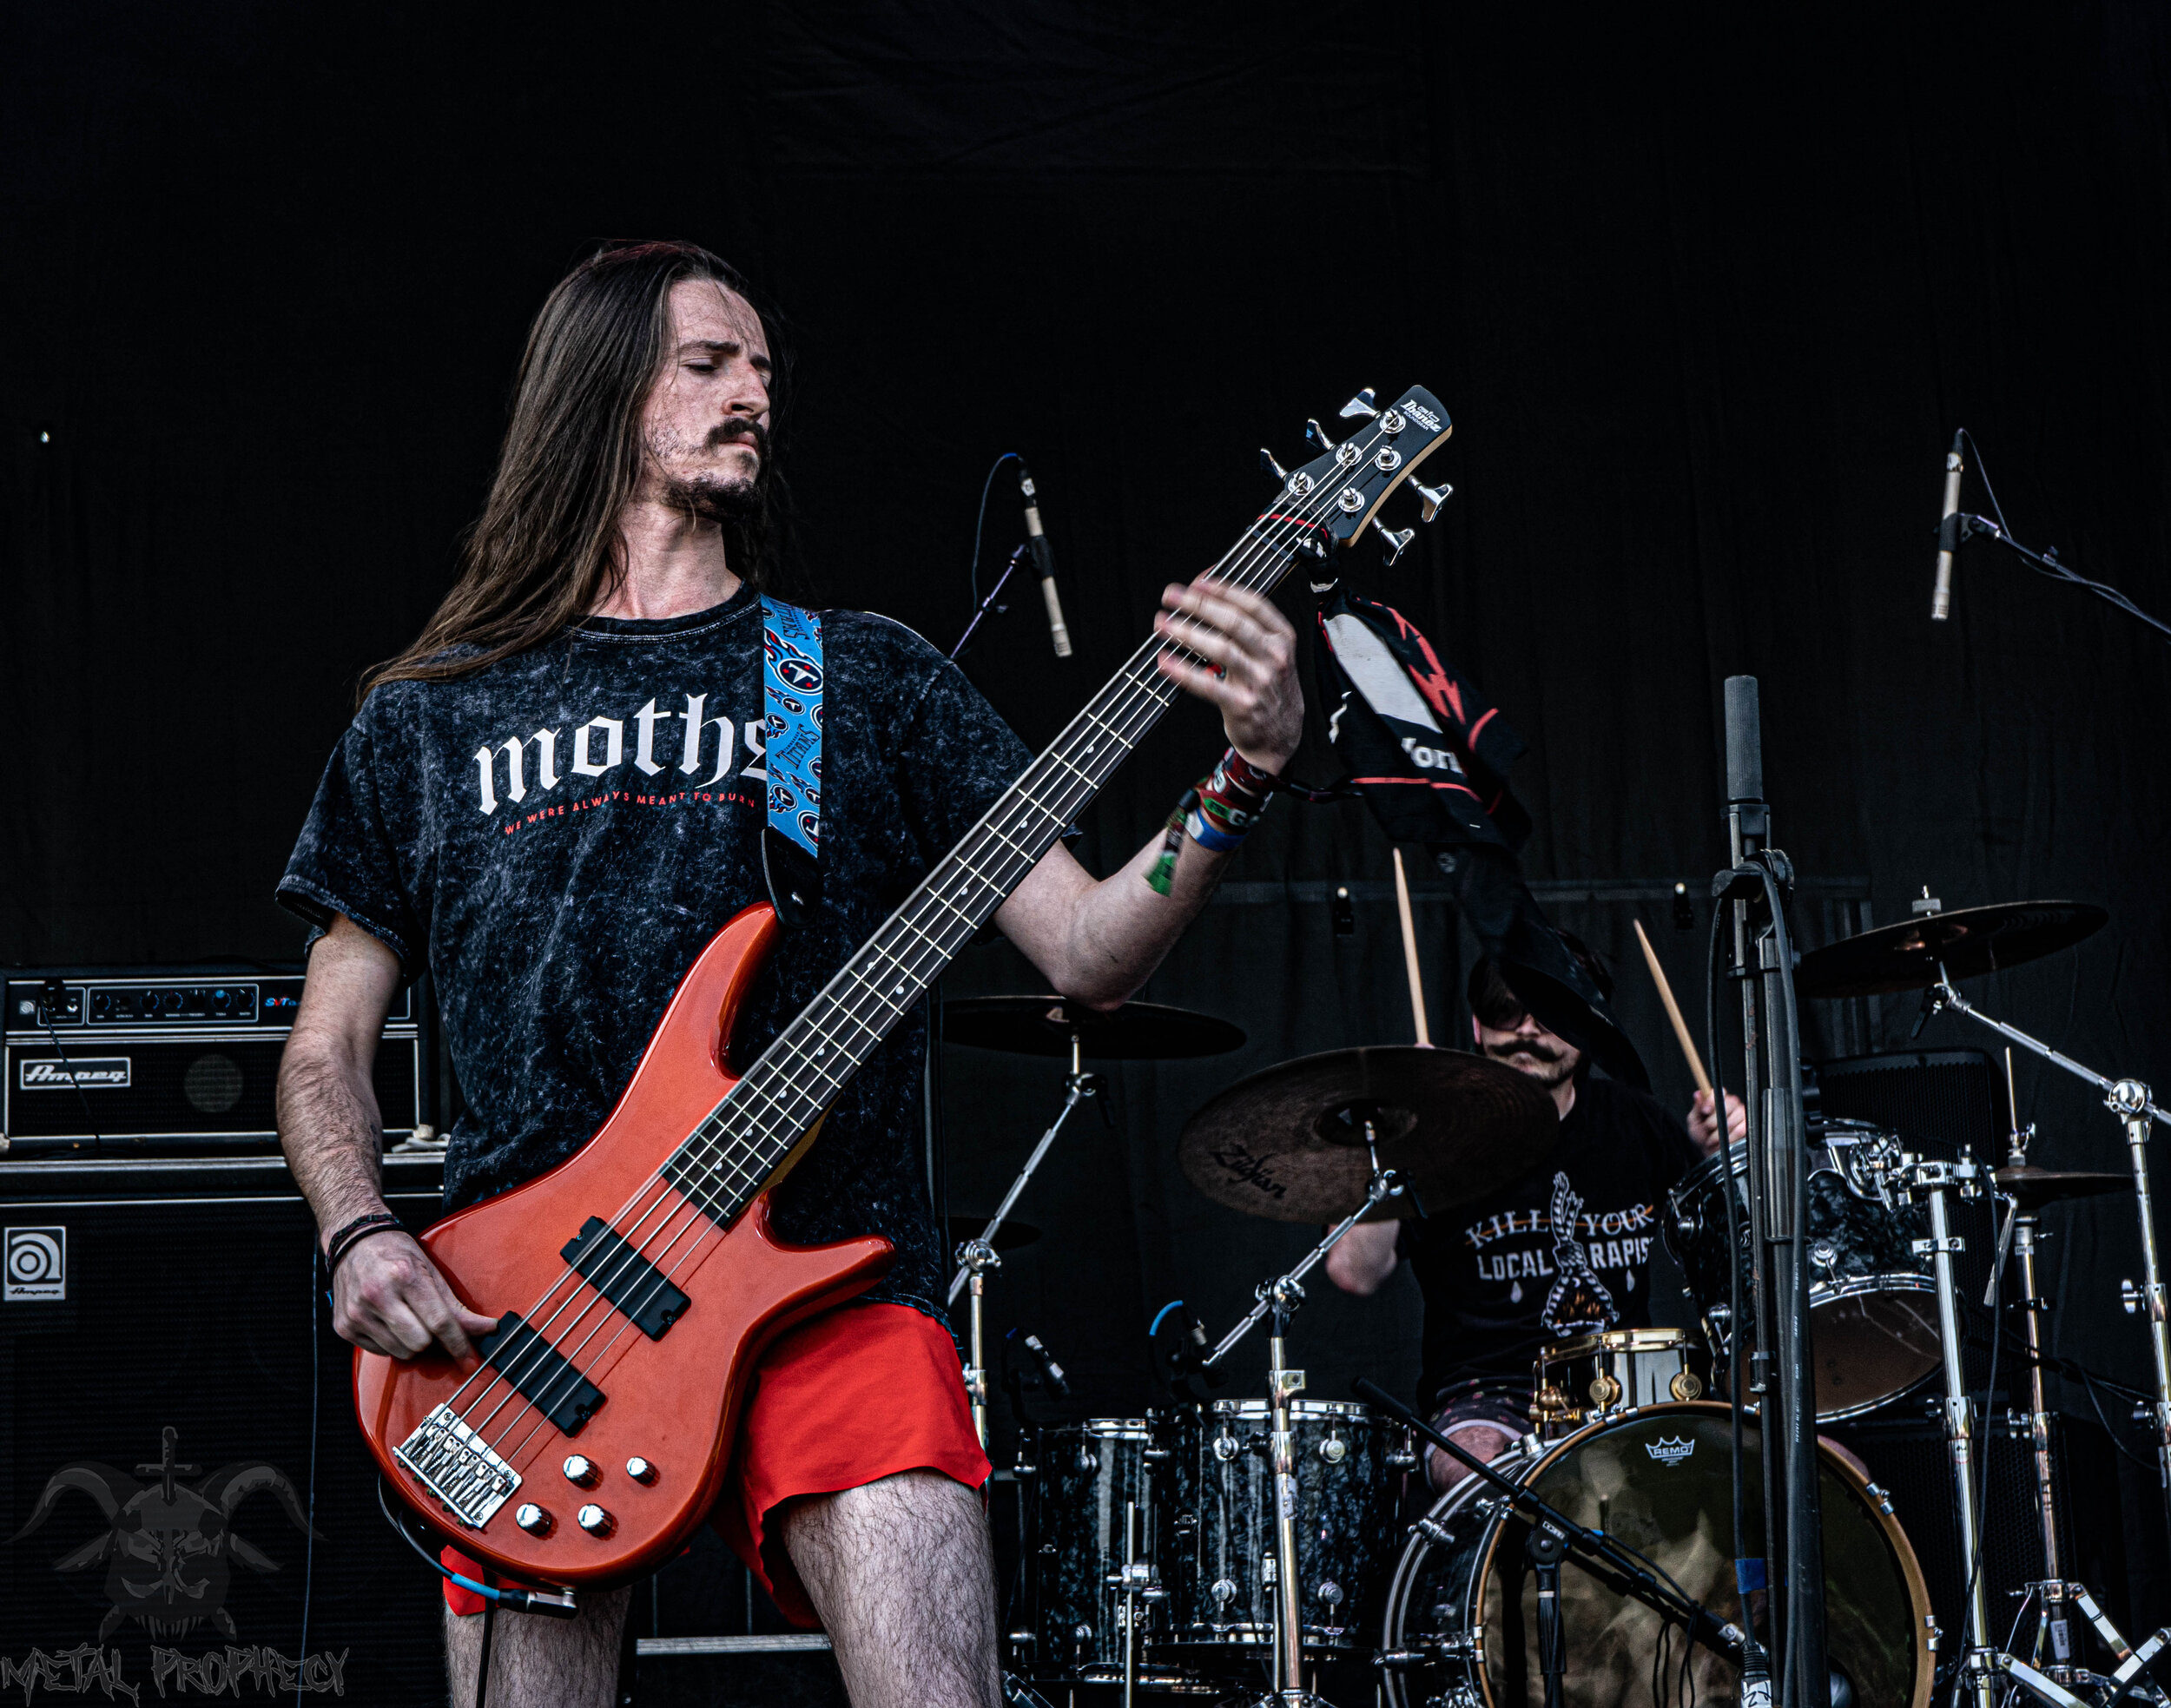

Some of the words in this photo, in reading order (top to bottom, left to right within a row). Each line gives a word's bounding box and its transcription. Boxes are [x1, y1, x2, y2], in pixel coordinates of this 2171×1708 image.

[1400, 399, 1442, 432] Ibanez
[472, 693, 769, 815] moths
[775, 723, 821, 771] TITANS
[505, 819, 522, 836] WE
[527, 806, 564, 825] WERE
[572, 790, 630, 812] ALWAYS
[637, 792, 686, 807] MEANT
[694, 792, 712, 802] TO
[718, 792, 756, 808] BURN
[24, 1065, 128, 1085] Ampeg
[1466, 1208, 1548, 1250] KILL
[1581, 1204, 1654, 1237] YOUR
[1477, 1249, 1554, 1281] LOCAL
[1589, 1236, 1654, 1269] RAPIS
[1653, 1446, 1689, 1456] REMO
